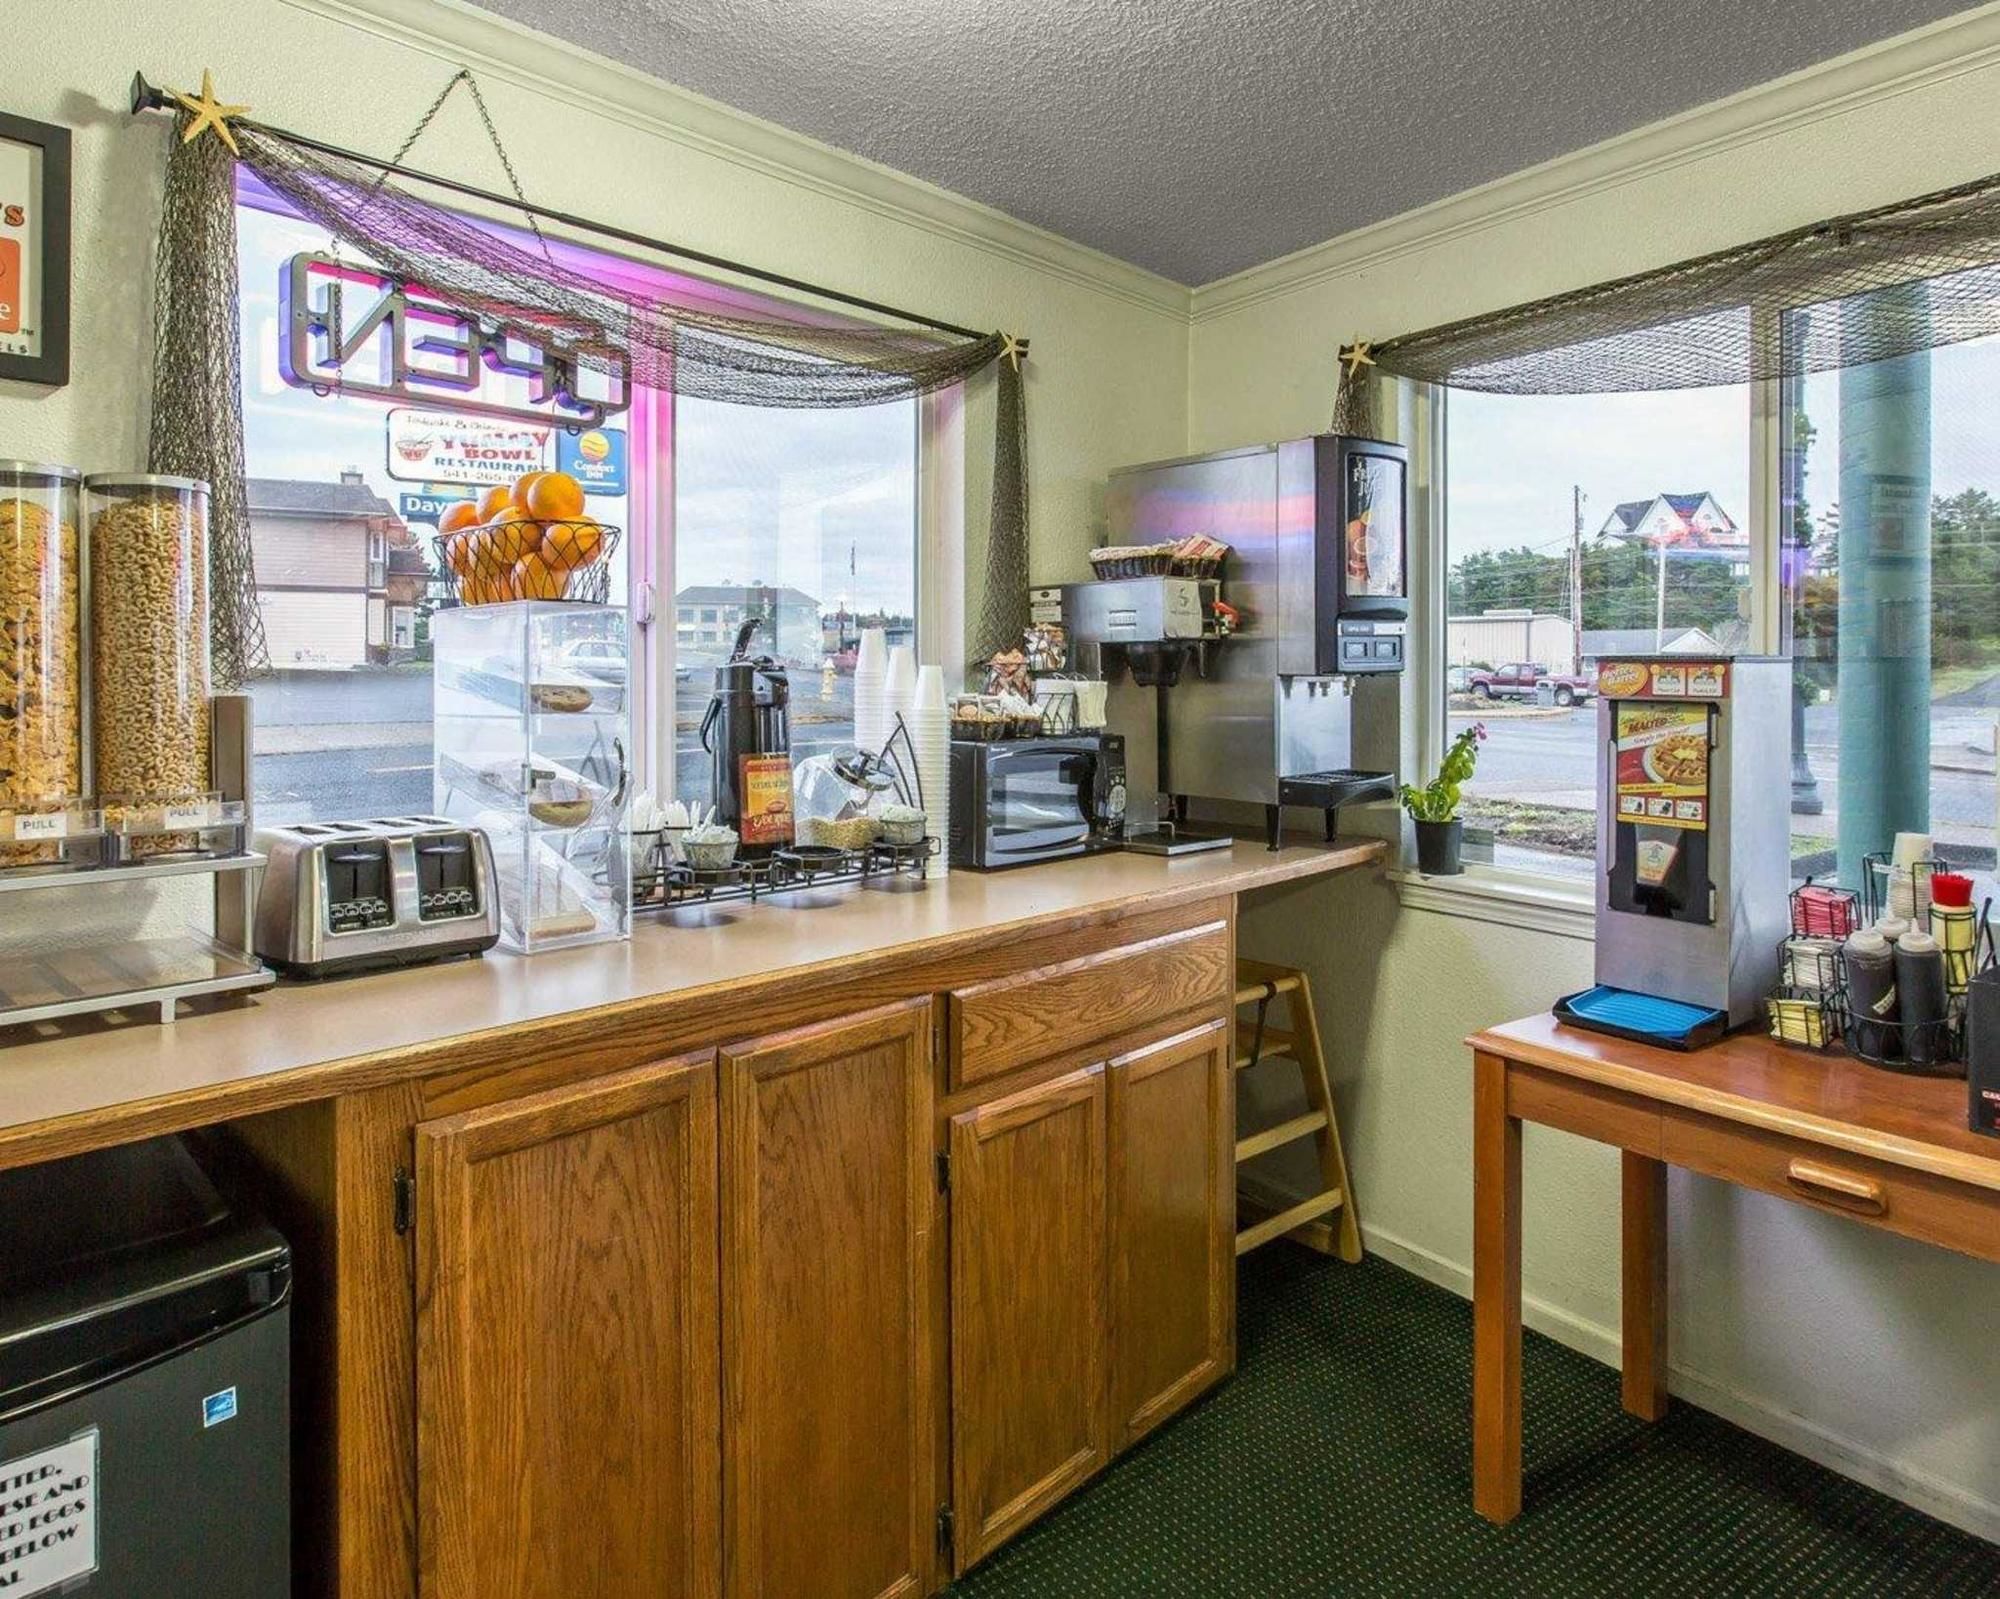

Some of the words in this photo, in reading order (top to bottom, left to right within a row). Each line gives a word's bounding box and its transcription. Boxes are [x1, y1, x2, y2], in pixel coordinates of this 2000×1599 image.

[464, 448, 536, 461] BOWL
[573, 460, 616, 473] Comfort
[168, 807, 199, 817] PULL
[22, 820, 56, 830] PULL
[43, 1475, 90, 1501] AND
[29, 1498, 86, 1531] EGGS
